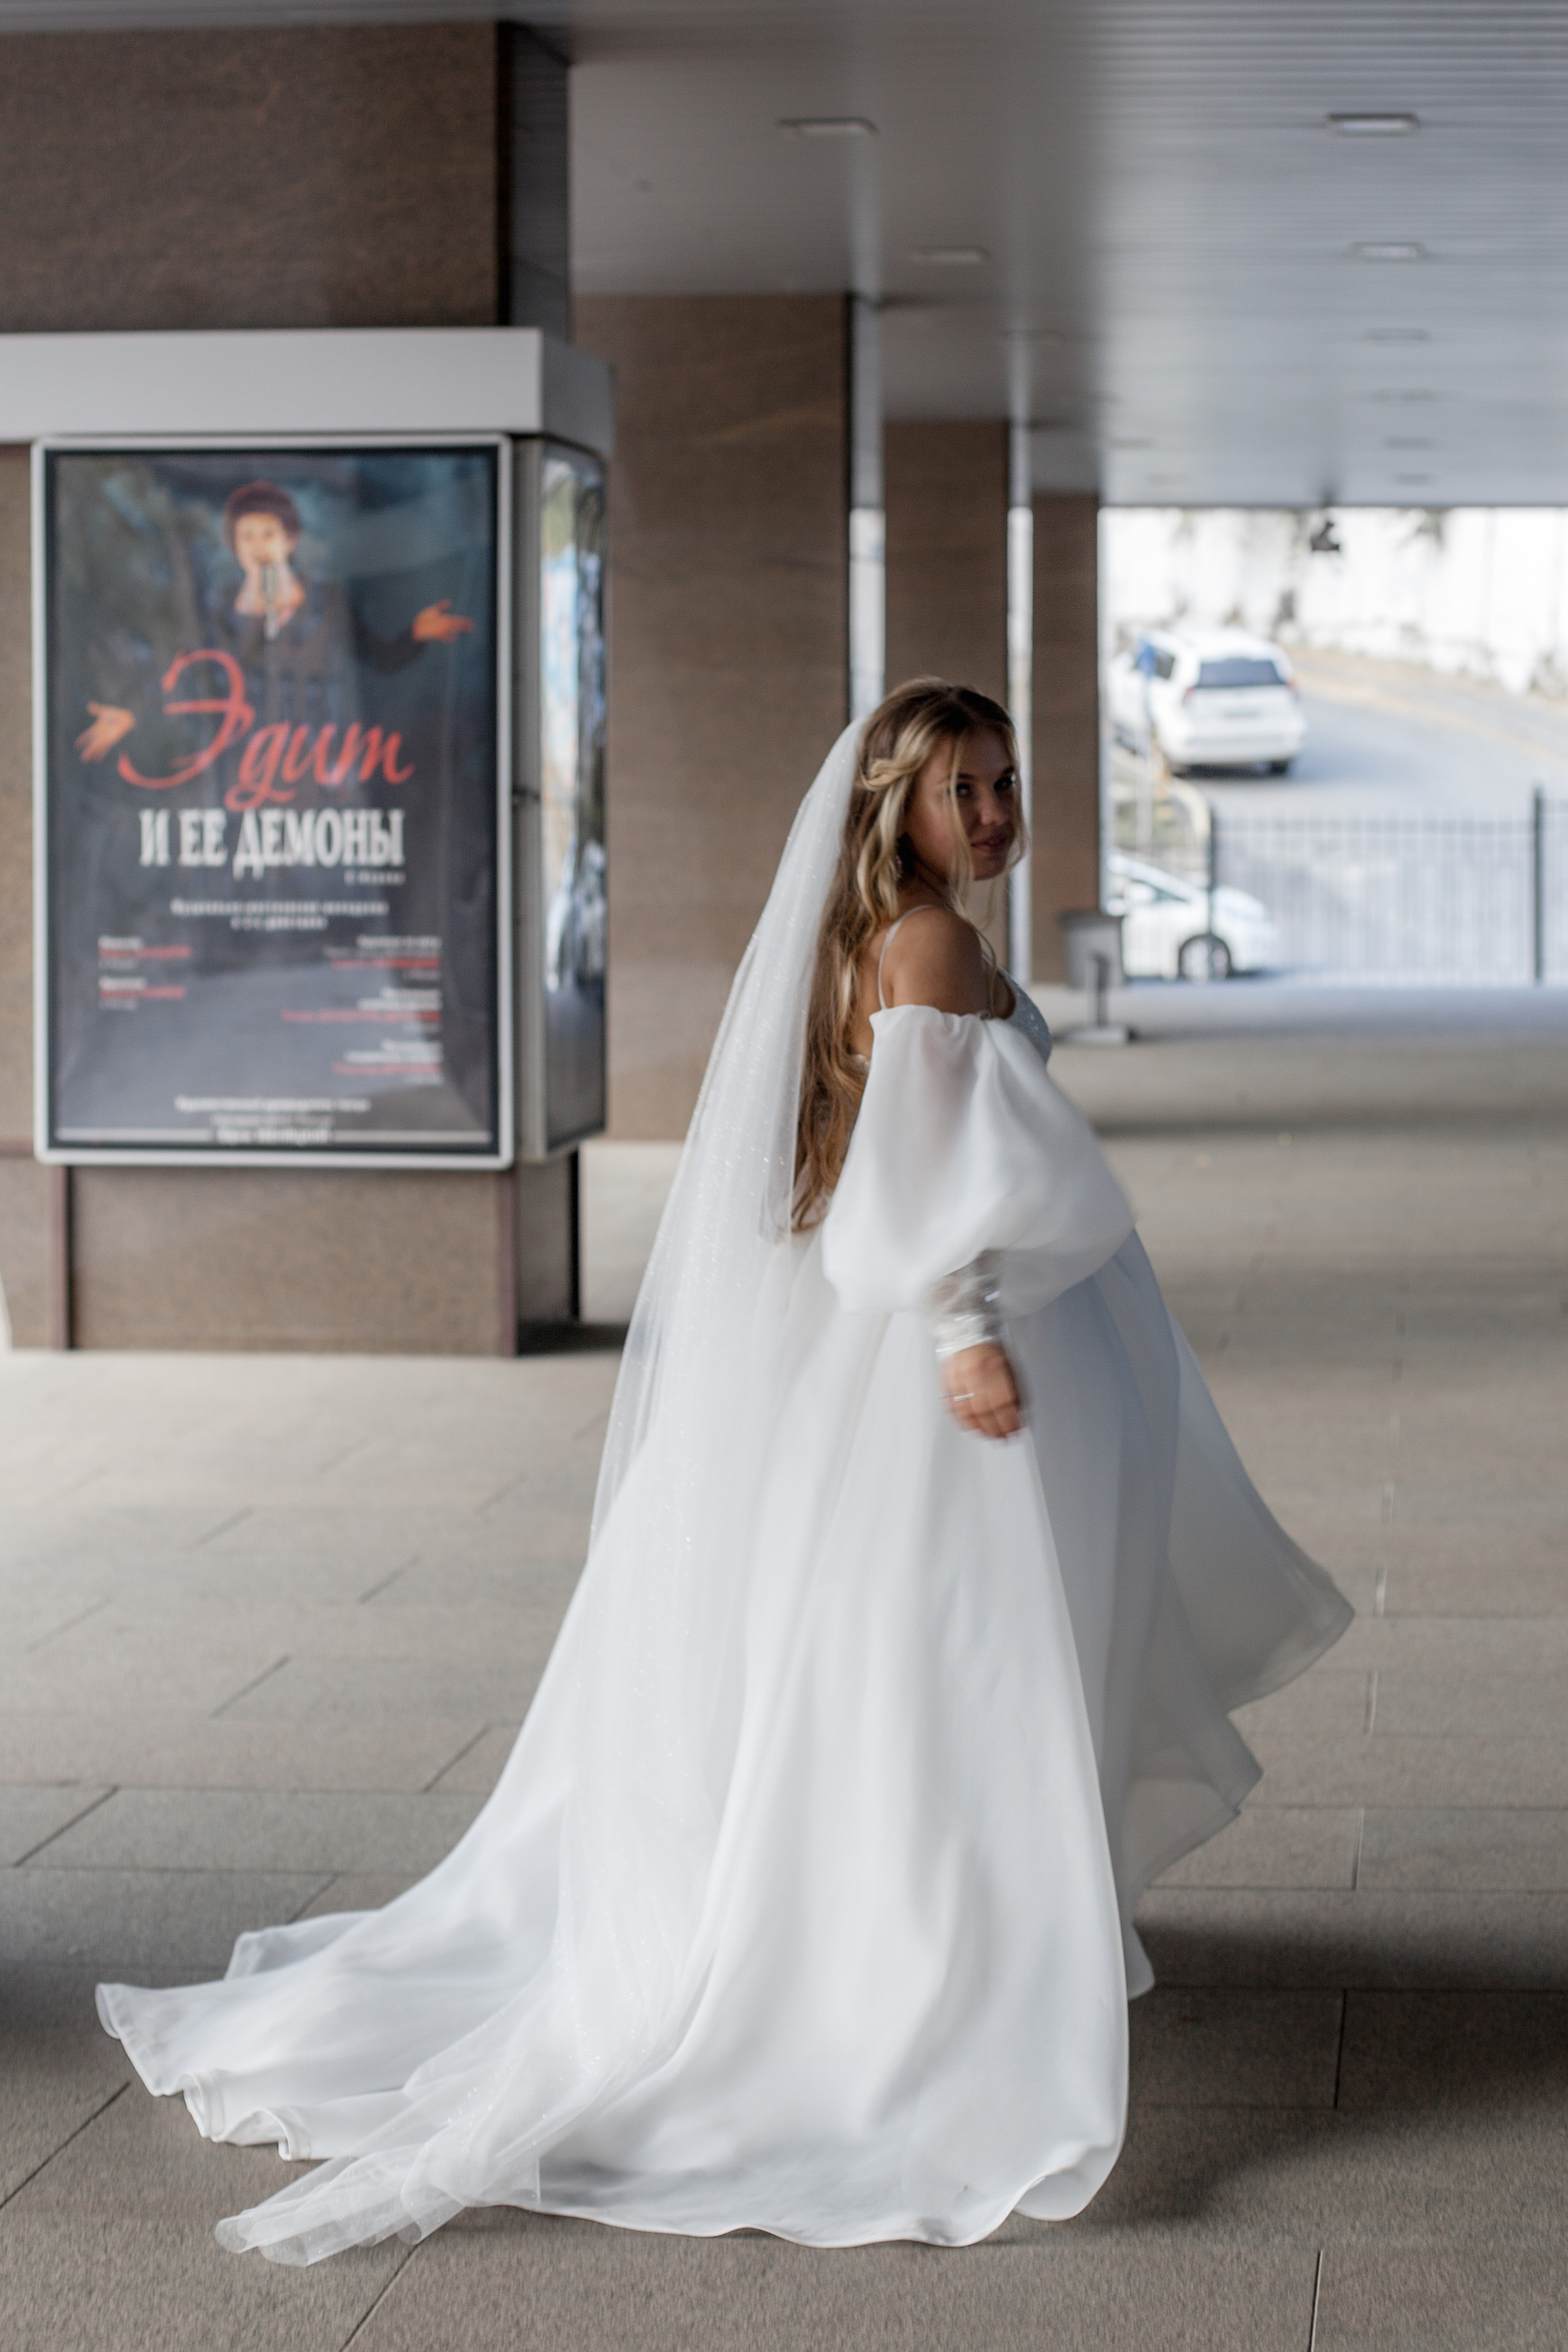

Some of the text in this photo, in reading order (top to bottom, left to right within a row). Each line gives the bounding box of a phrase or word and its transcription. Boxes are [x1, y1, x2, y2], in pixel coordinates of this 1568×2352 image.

[117, 648, 415, 812] Эдит
[138, 807, 405, 881] И ЕЕ ДЕМОНЫ
